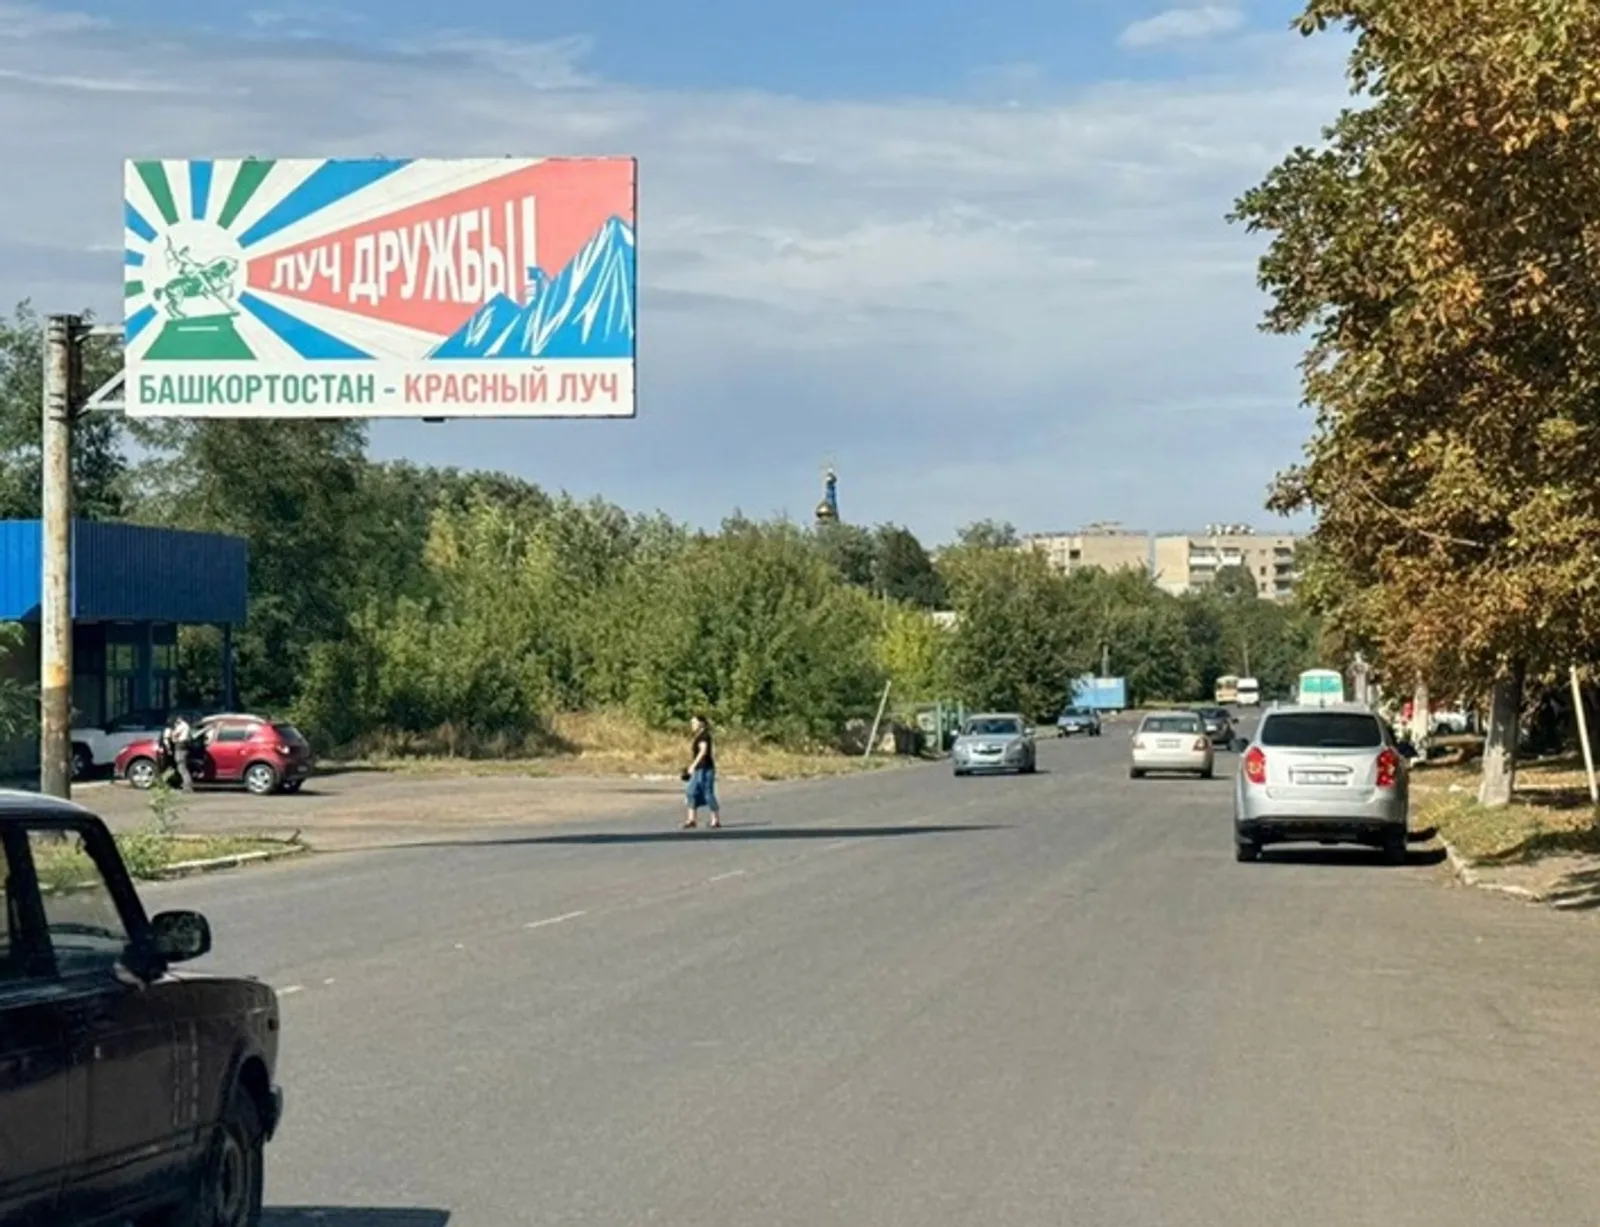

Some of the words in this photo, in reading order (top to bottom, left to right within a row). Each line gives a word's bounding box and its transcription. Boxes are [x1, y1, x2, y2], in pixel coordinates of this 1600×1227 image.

[270, 238, 342, 293] ЛУЧ
[349, 196, 536, 304] ДРУЖБЫ!
[139, 373, 375, 404] БАШКОРТОСТАН
[404, 366, 547, 404] КРАСНЫЙ
[557, 373, 618, 403] ЛУЧ
